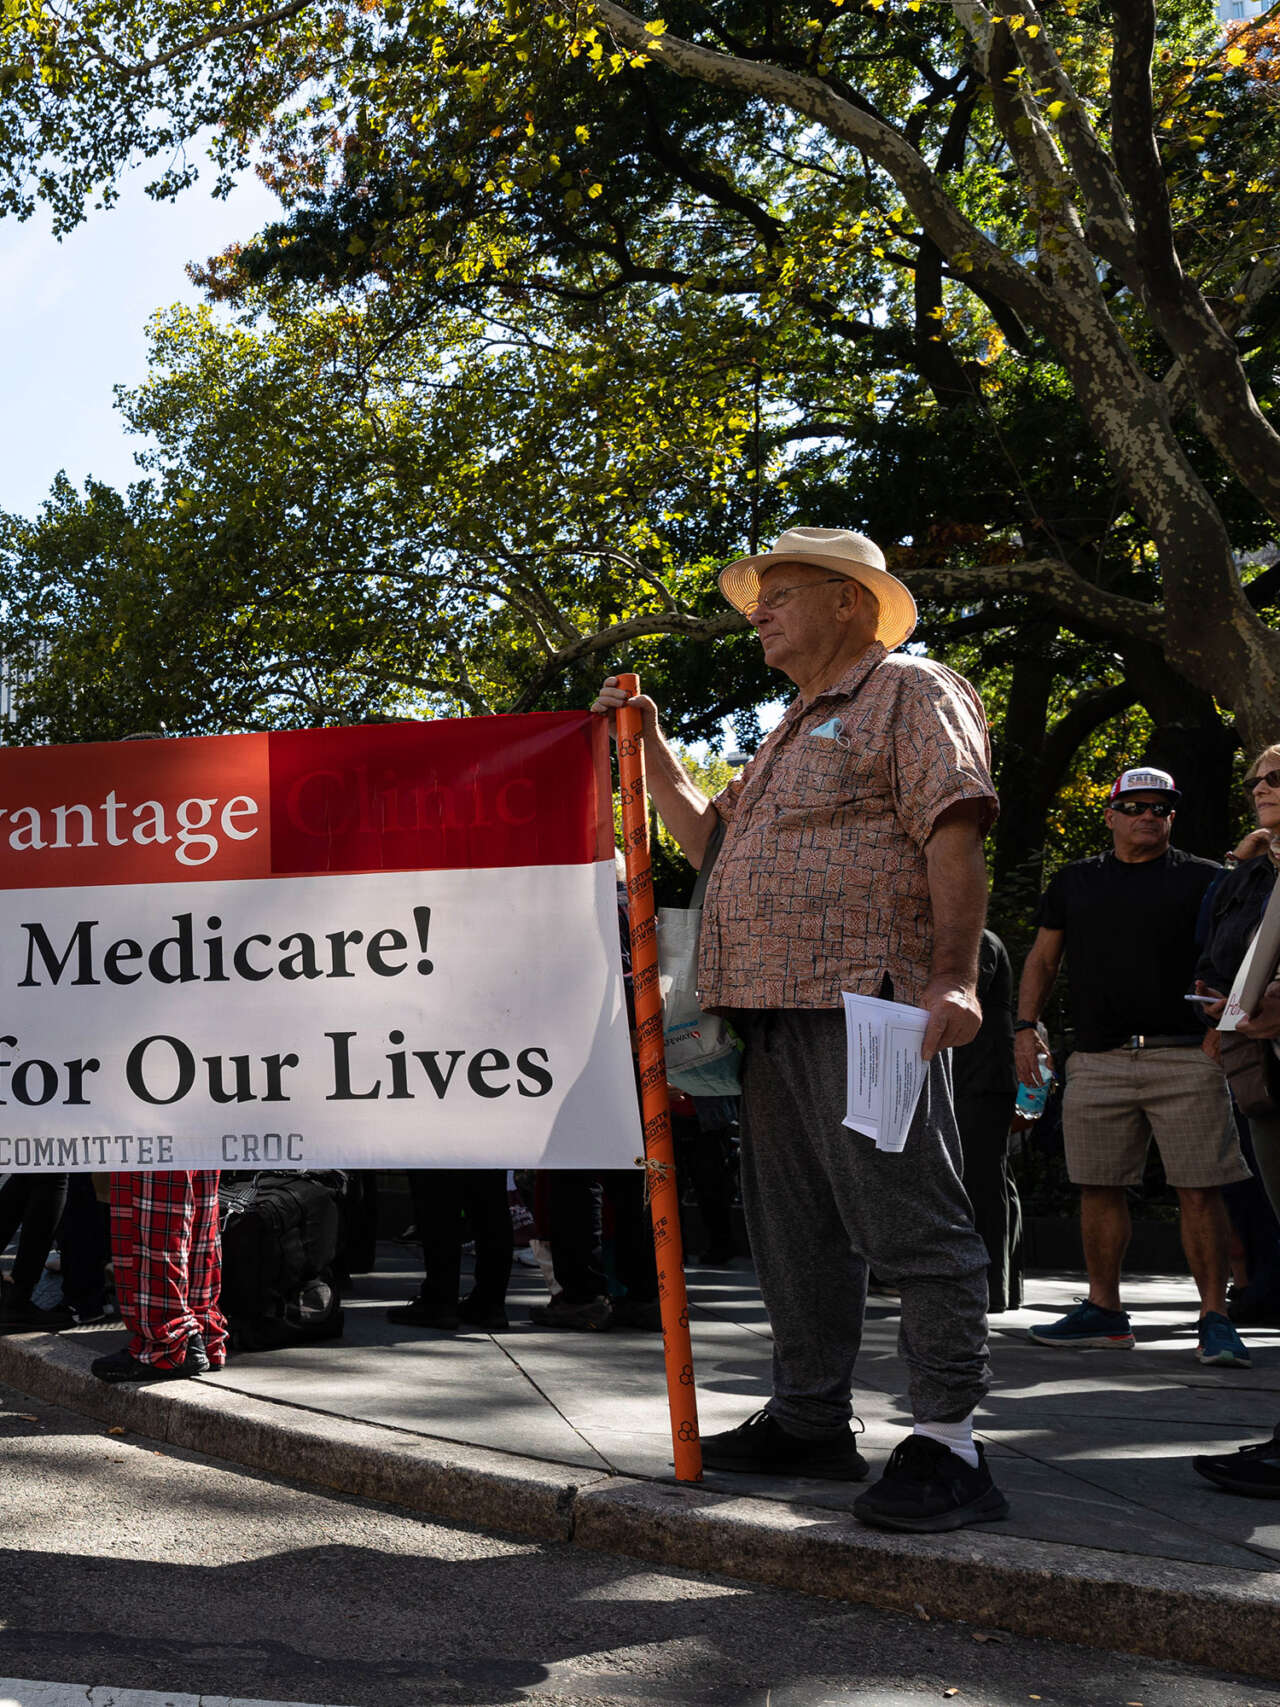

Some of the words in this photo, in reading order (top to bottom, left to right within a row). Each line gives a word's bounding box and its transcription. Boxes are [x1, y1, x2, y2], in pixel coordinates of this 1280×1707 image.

[17, 906, 434, 988] Medicare!
[126, 1034, 300, 1105] Our
[324, 1029, 554, 1101] Lives
[221, 1133, 304, 1162] CROC
